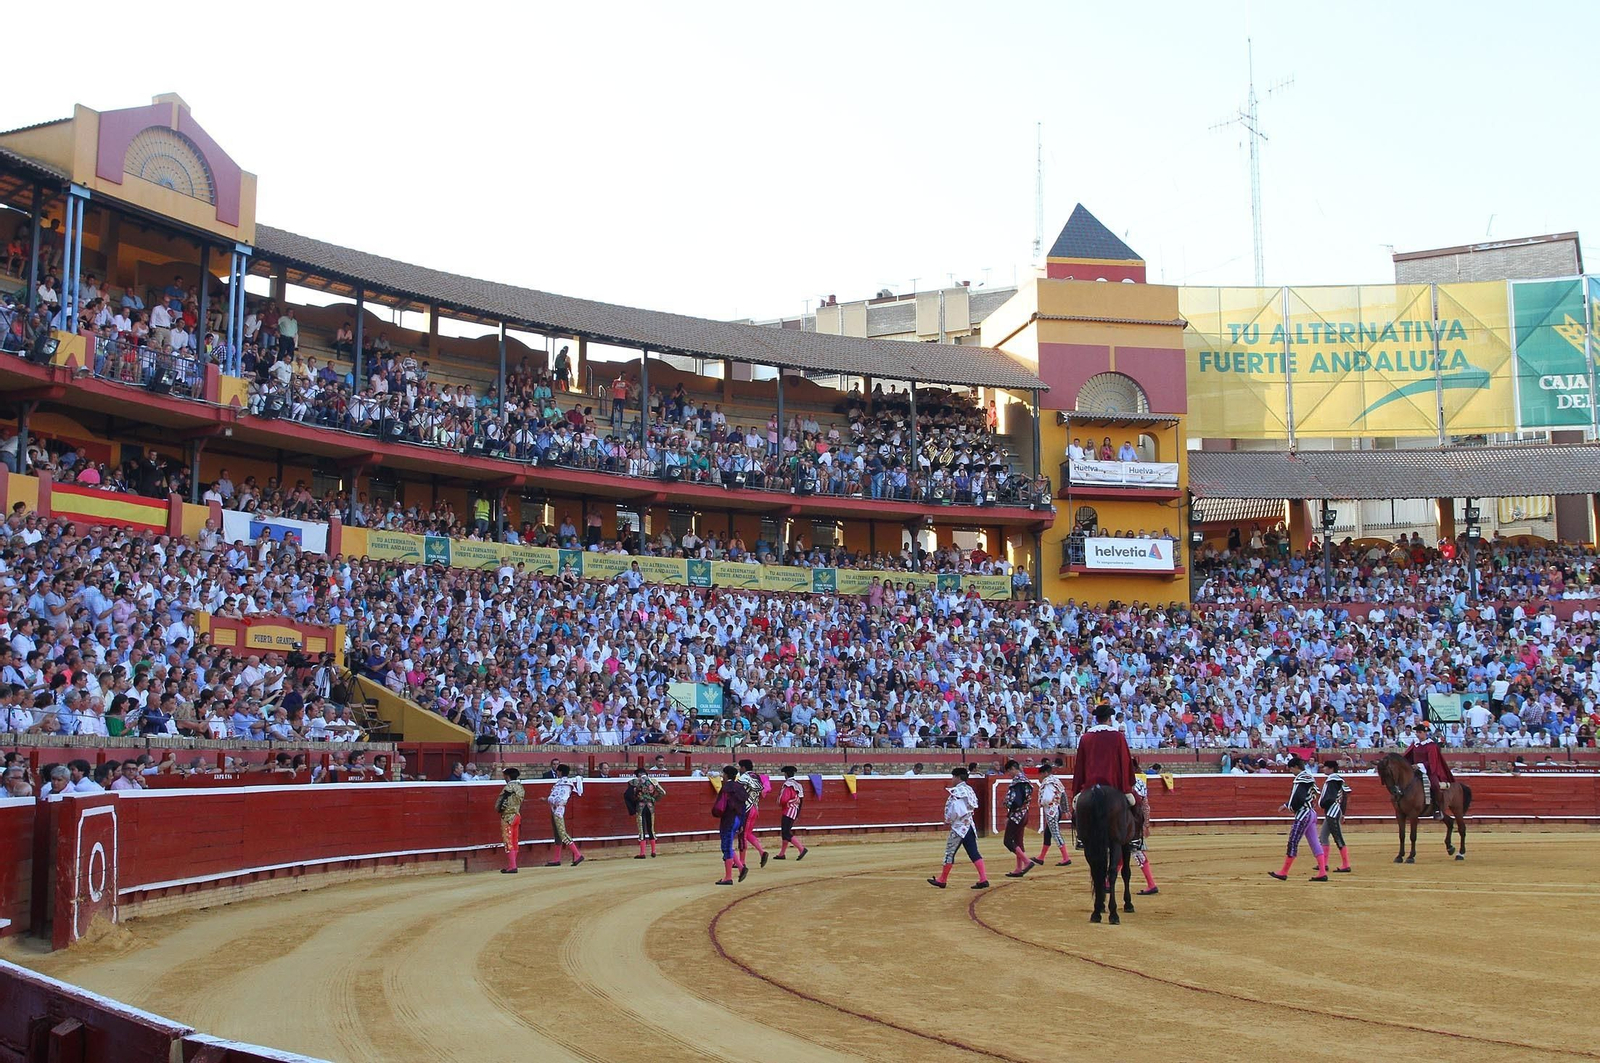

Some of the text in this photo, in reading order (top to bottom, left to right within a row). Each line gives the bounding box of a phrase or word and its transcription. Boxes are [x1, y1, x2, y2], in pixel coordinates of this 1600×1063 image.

[1228, 319, 1468, 345] TU ALTERNATIVA
[1200, 349, 1471, 374] FUERTE ANDALUZA
[1539, 374, 1590, 391] CAJA
[1073, 464, 1099, 472] Huelva
[1128, 466, 1154, 475] Huelva
[1095, 545, 1147, 558] helvetia
[254, 634, 273, 643] PUERTA
